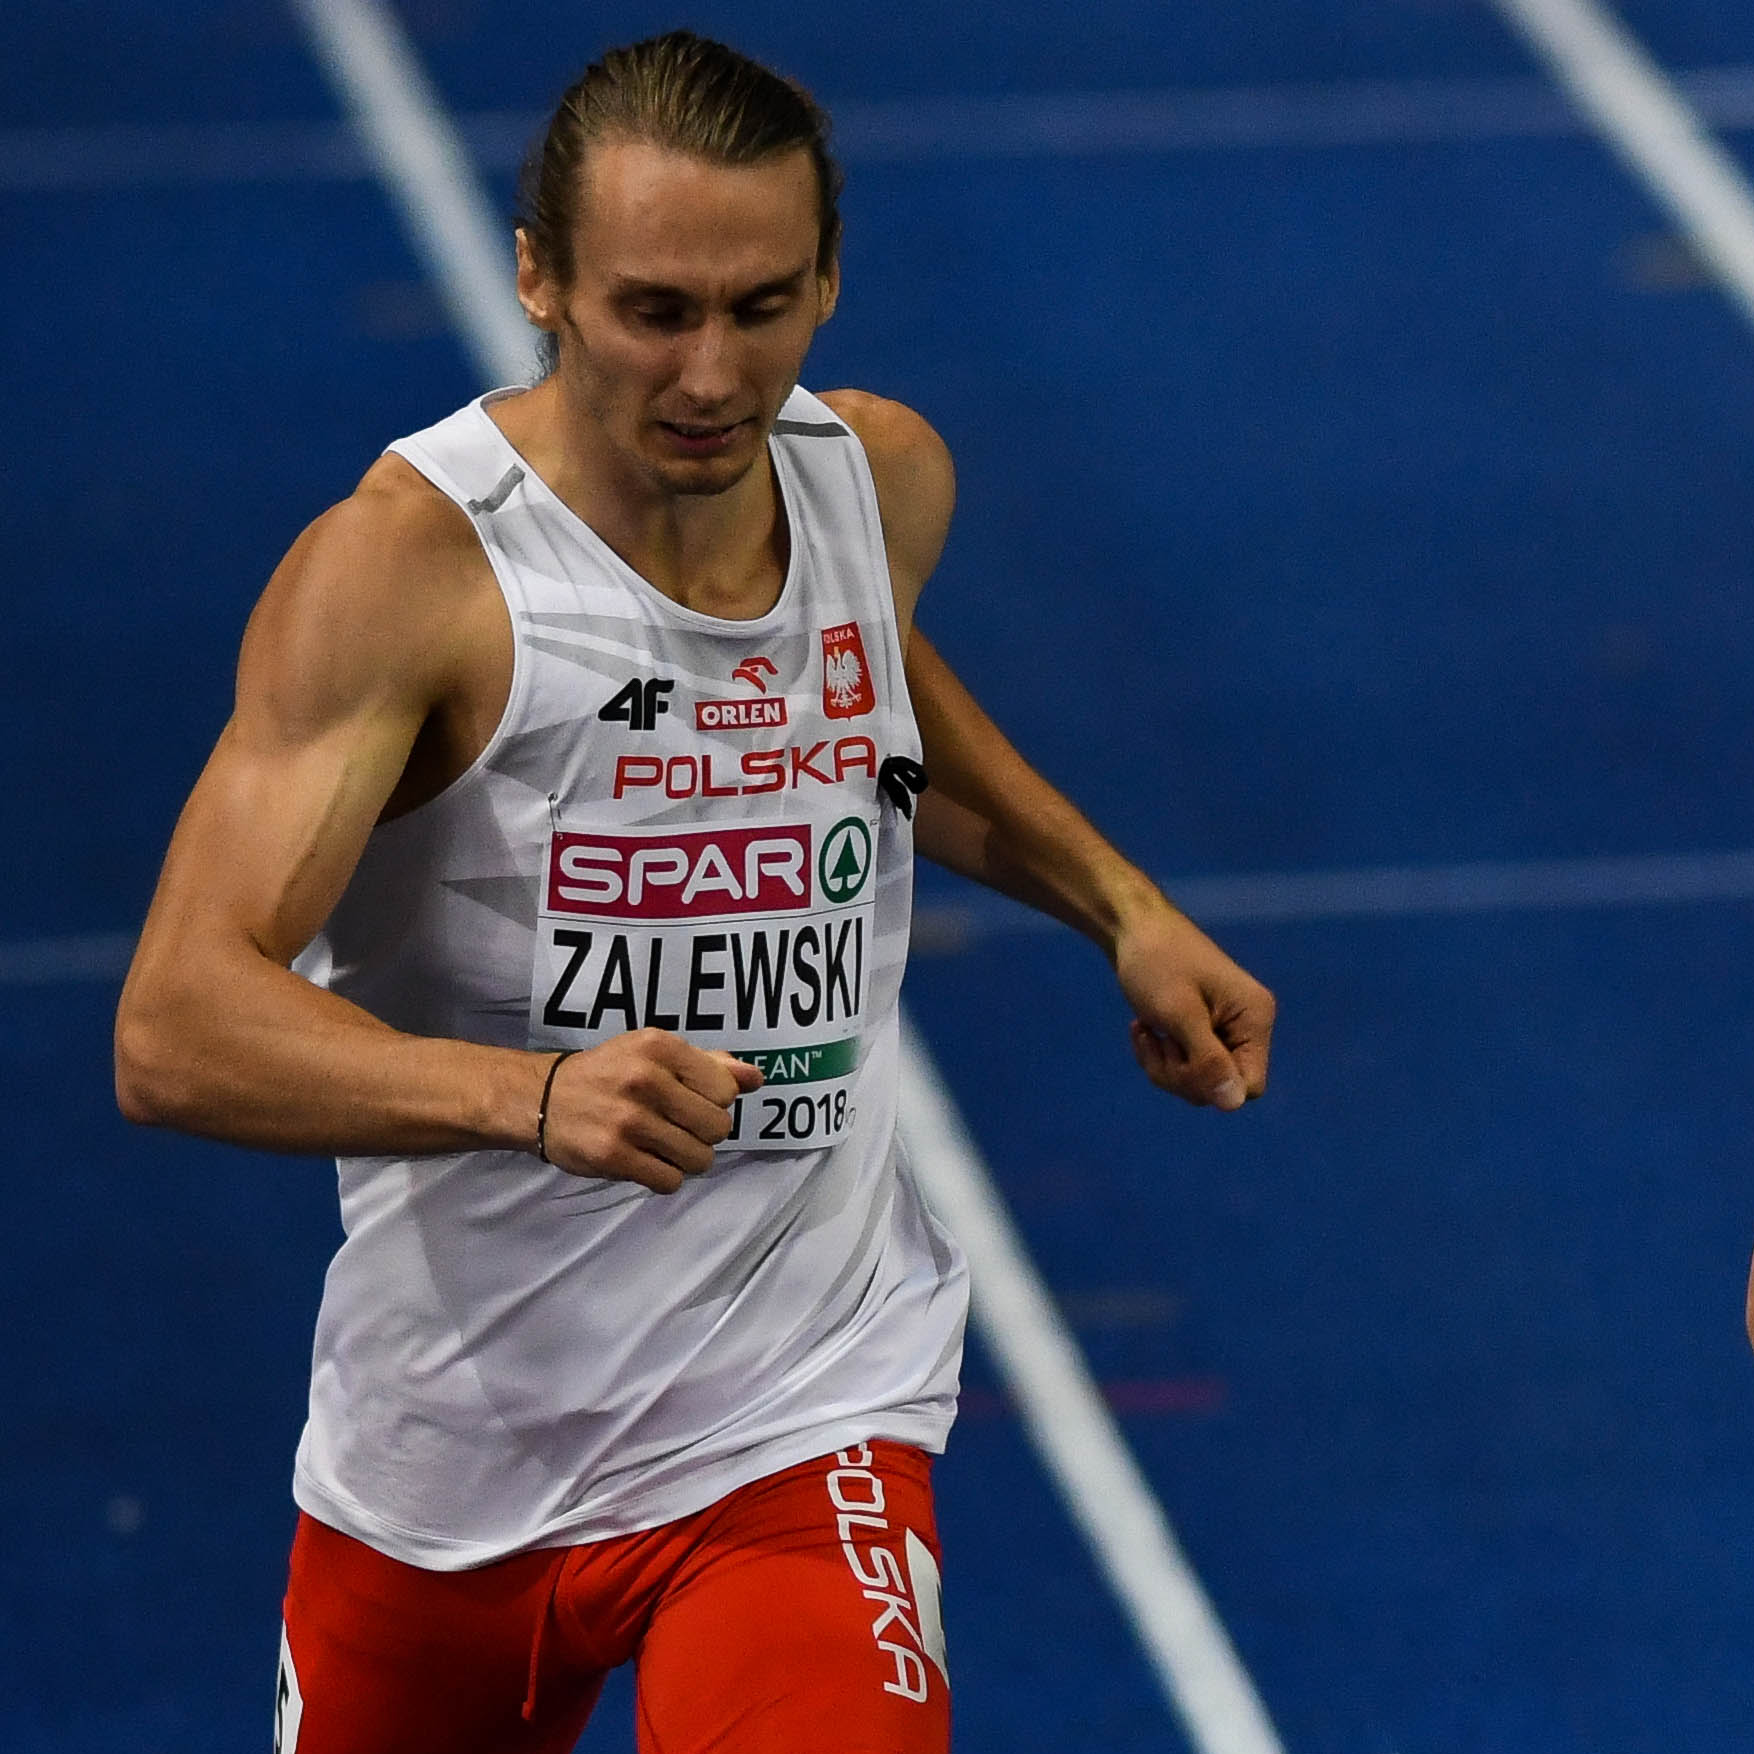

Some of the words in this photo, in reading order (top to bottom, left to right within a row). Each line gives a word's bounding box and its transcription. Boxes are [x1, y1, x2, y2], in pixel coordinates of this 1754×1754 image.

[597, 677, 675, 731] 4F
[700, 701, 781, 726] ORLEN
[612, 736, 878, 800] POLSKA
[557, 838, 805, 906] SPAR
[542, 917, 865, 1032] ZALEWSKI
[758, 1088, 847, 1140] 2018
